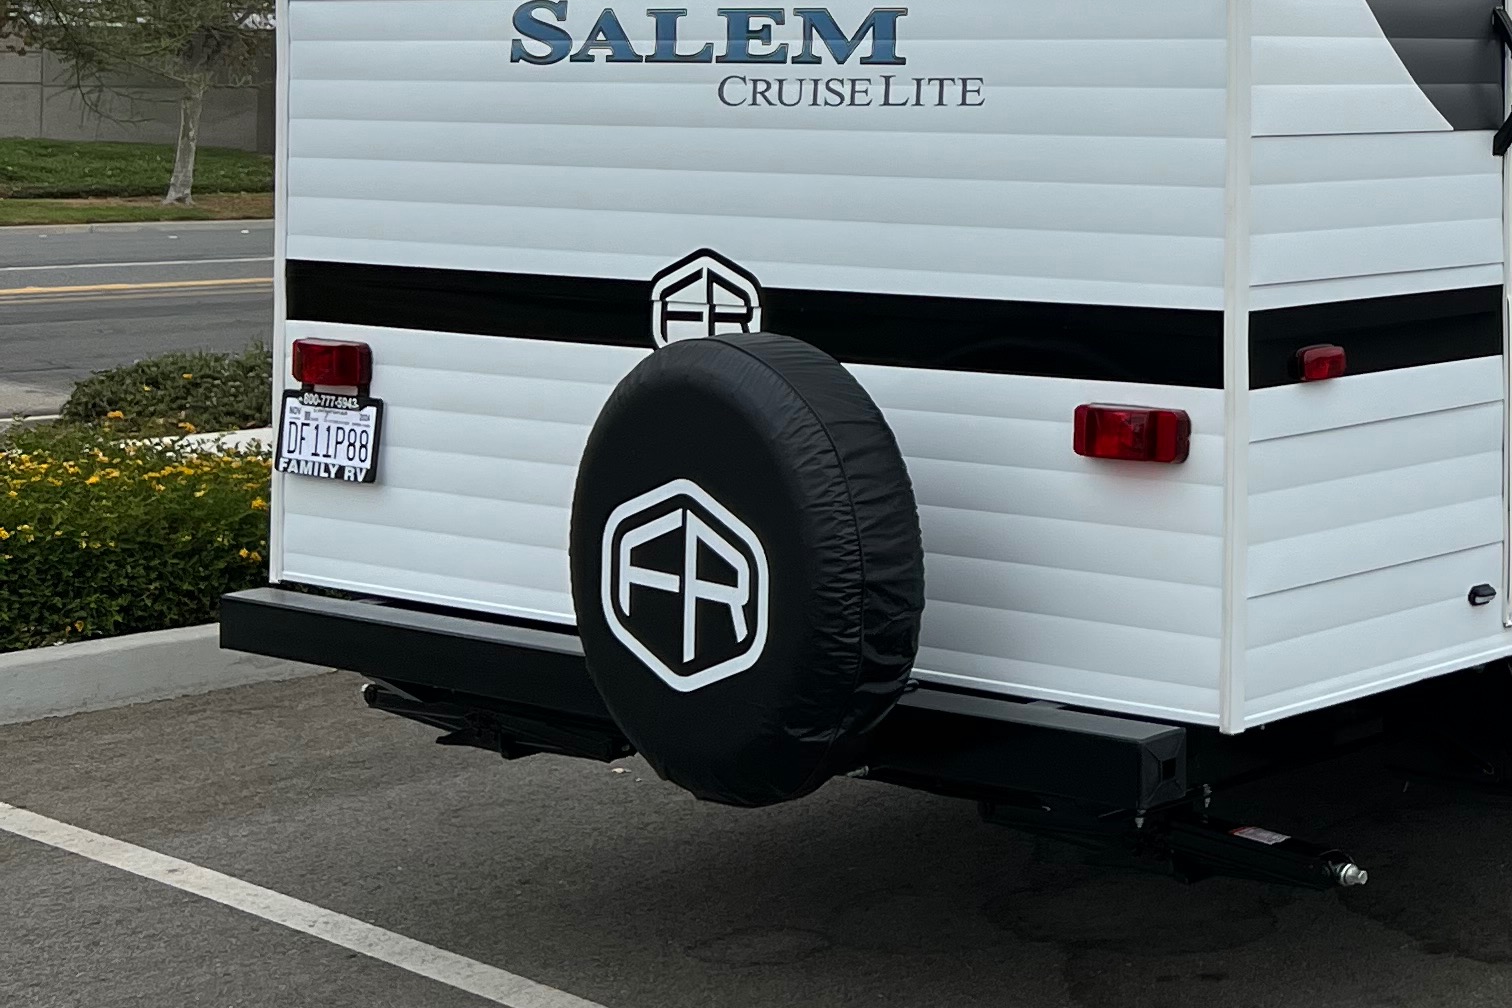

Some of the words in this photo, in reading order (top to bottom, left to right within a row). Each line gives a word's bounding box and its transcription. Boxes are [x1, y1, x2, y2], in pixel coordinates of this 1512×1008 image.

[510, 0, 908, 65] SALEM
[287, 421, 370, 463] DF11P88
[278, 458, 340, 479] FAMILY
[344, 467, 368, 483] RV
